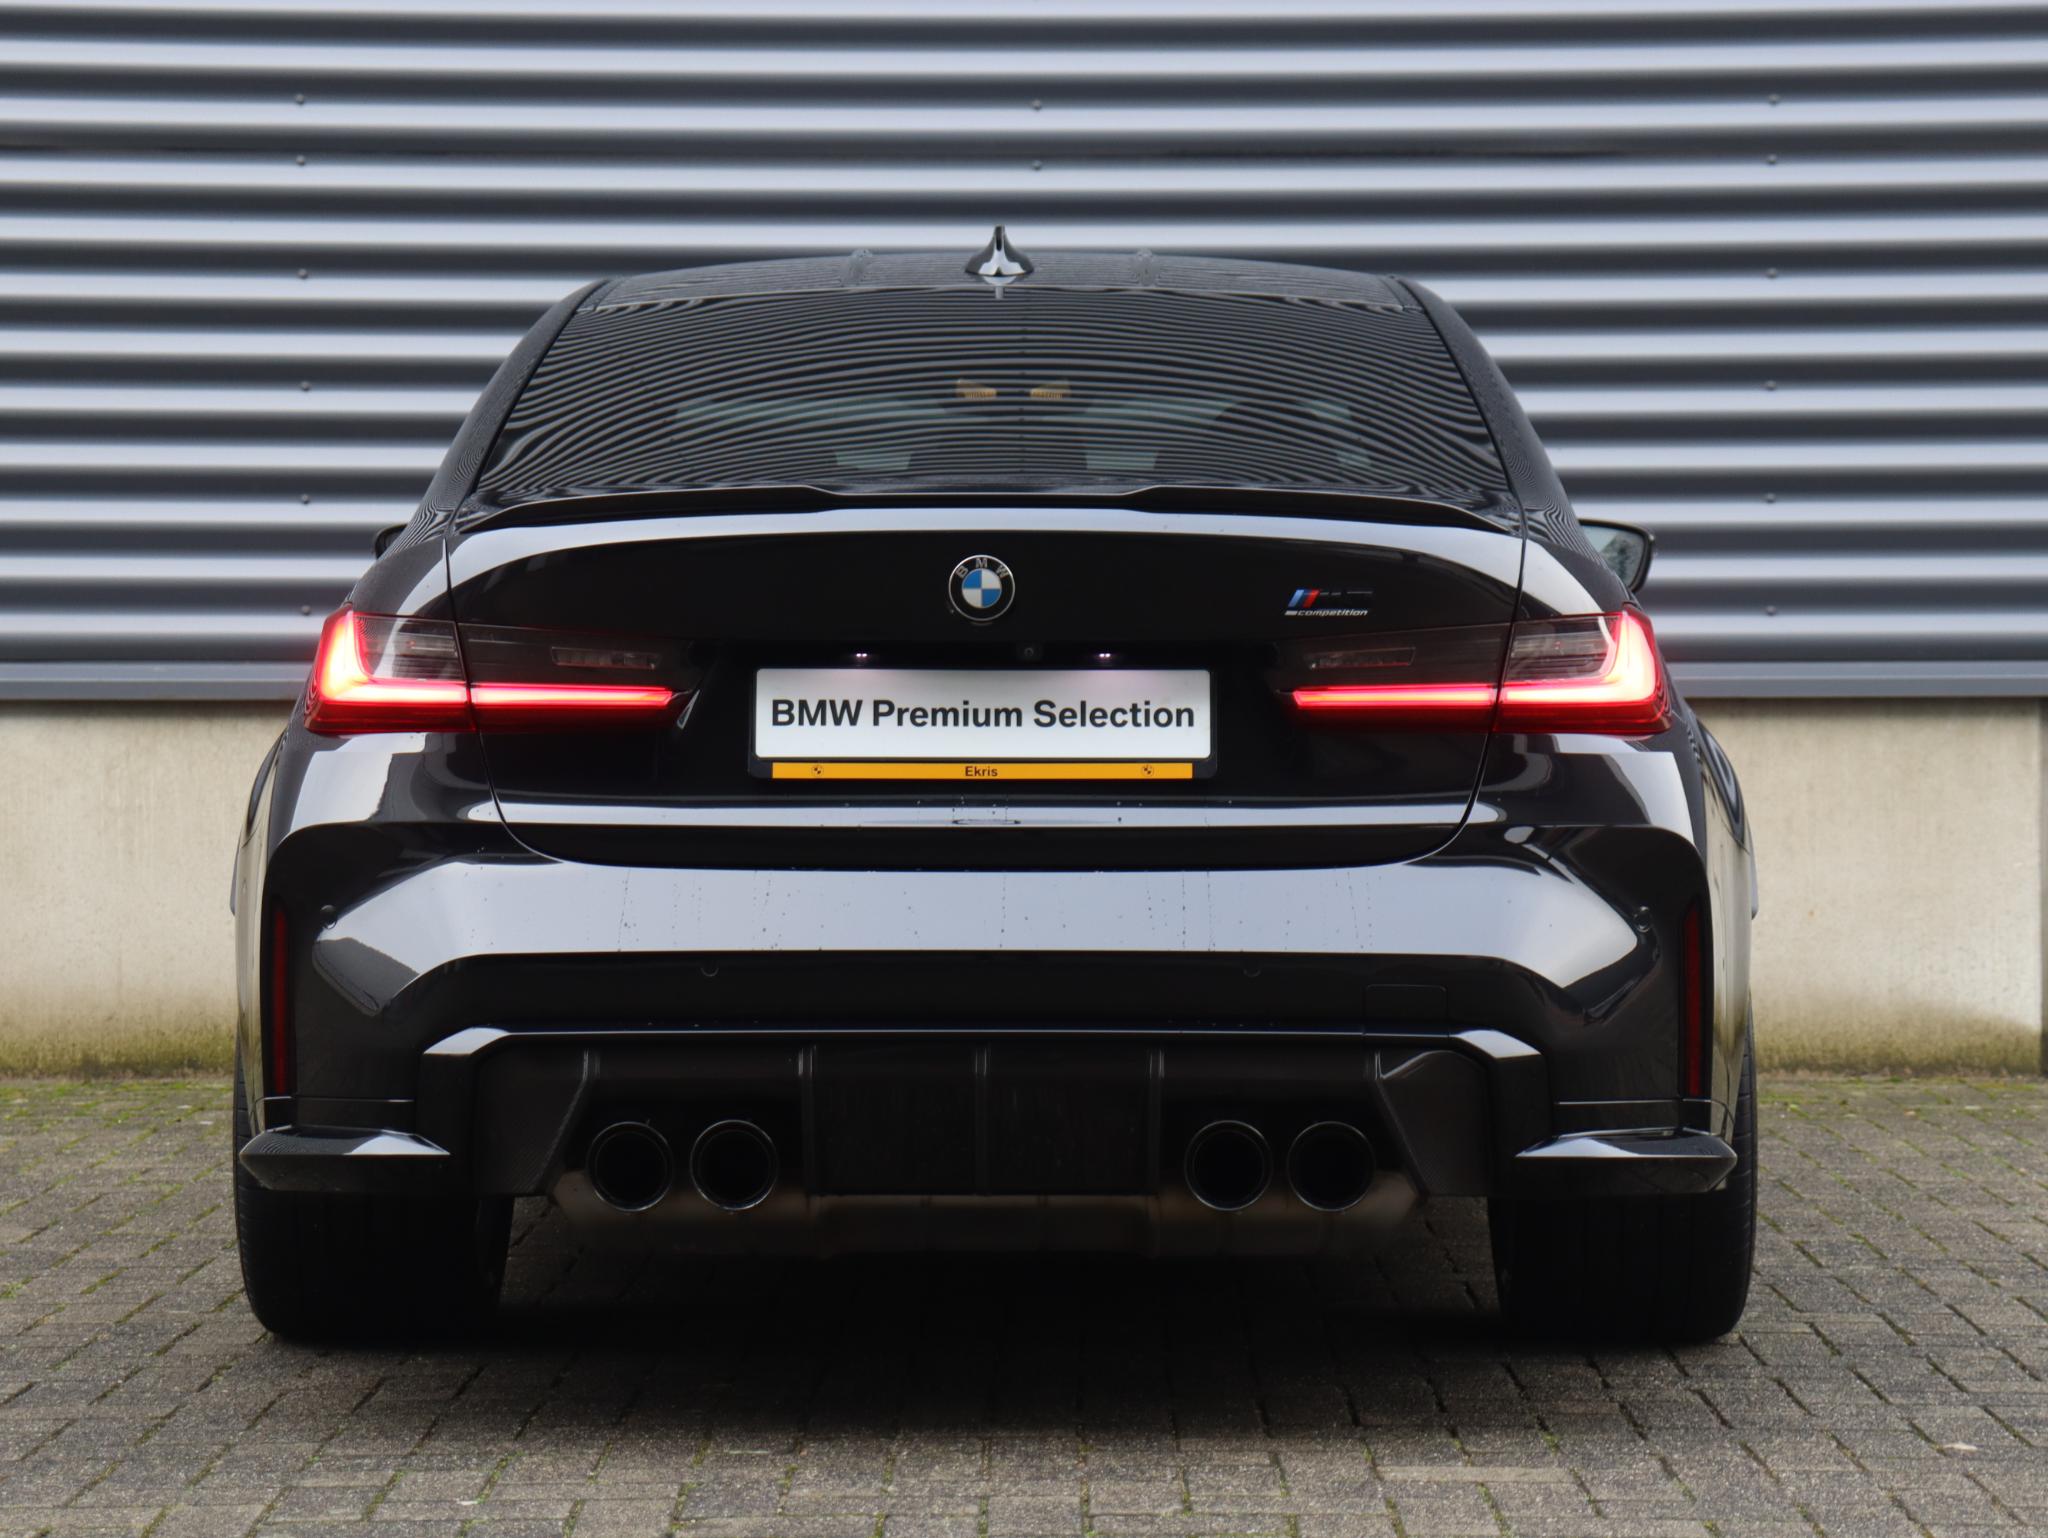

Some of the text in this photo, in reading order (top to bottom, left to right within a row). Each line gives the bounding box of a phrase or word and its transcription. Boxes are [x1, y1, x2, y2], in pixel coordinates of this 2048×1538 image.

[955, 557, 1010, 579] BMW
[1297, 608, 1369, 617] competition
[772, 699, 1195, 728] BMW Premium Selection
[964, 765, 998, 777] Ekris
